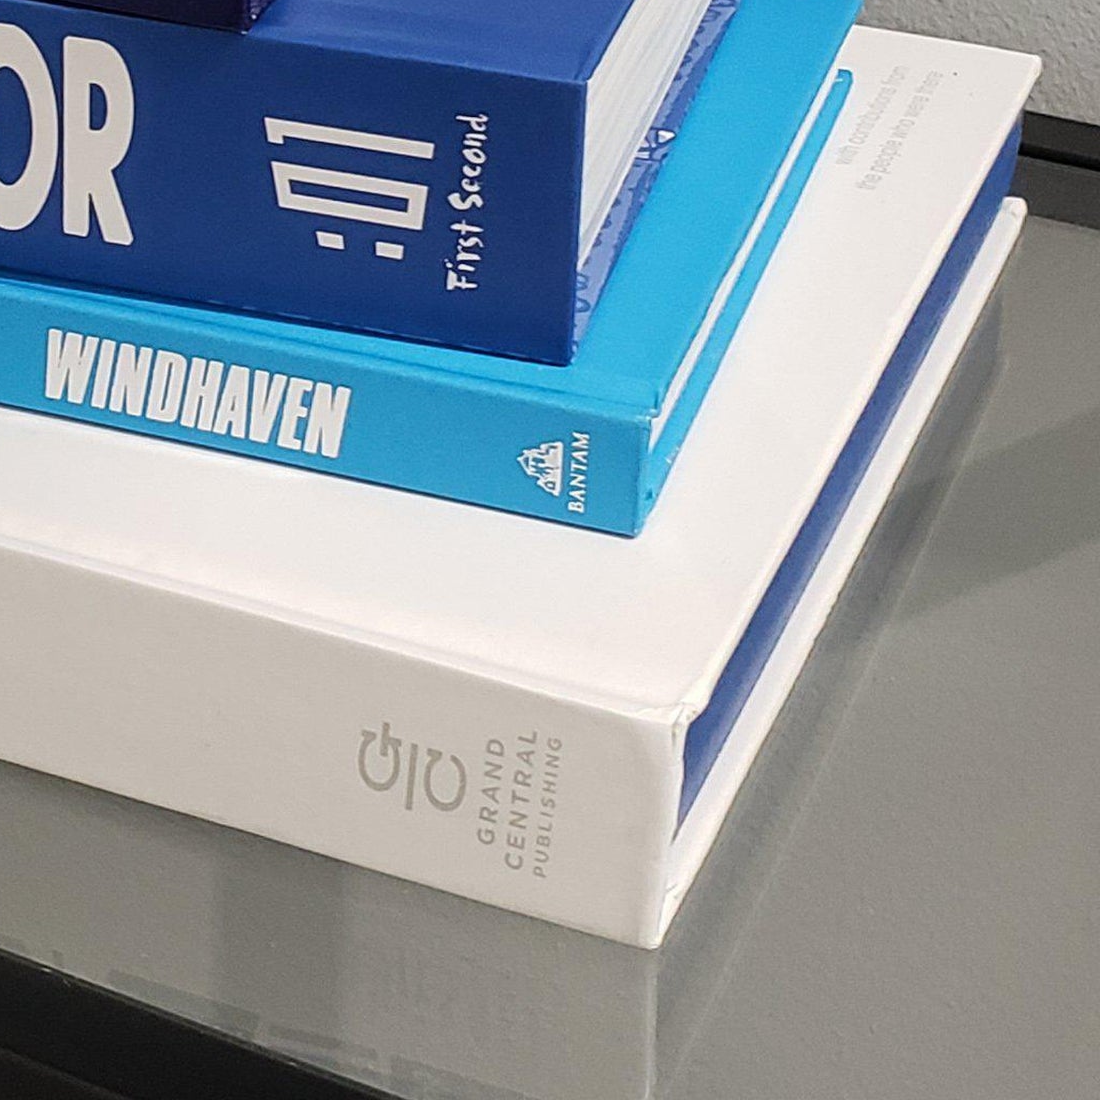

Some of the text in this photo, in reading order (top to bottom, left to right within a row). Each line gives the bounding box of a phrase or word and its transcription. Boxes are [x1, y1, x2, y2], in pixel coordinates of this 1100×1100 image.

[444, 113, 489, 291] First Second
[45, 328, 351, 459] WINDHAVEN
[567, 432, 591, 514] BANTAM
[477, 738, 505, 846] GRAND
[504, 730, 538, 870] CENTRAL
[533, 737, 563, 879] PUBLISHING
